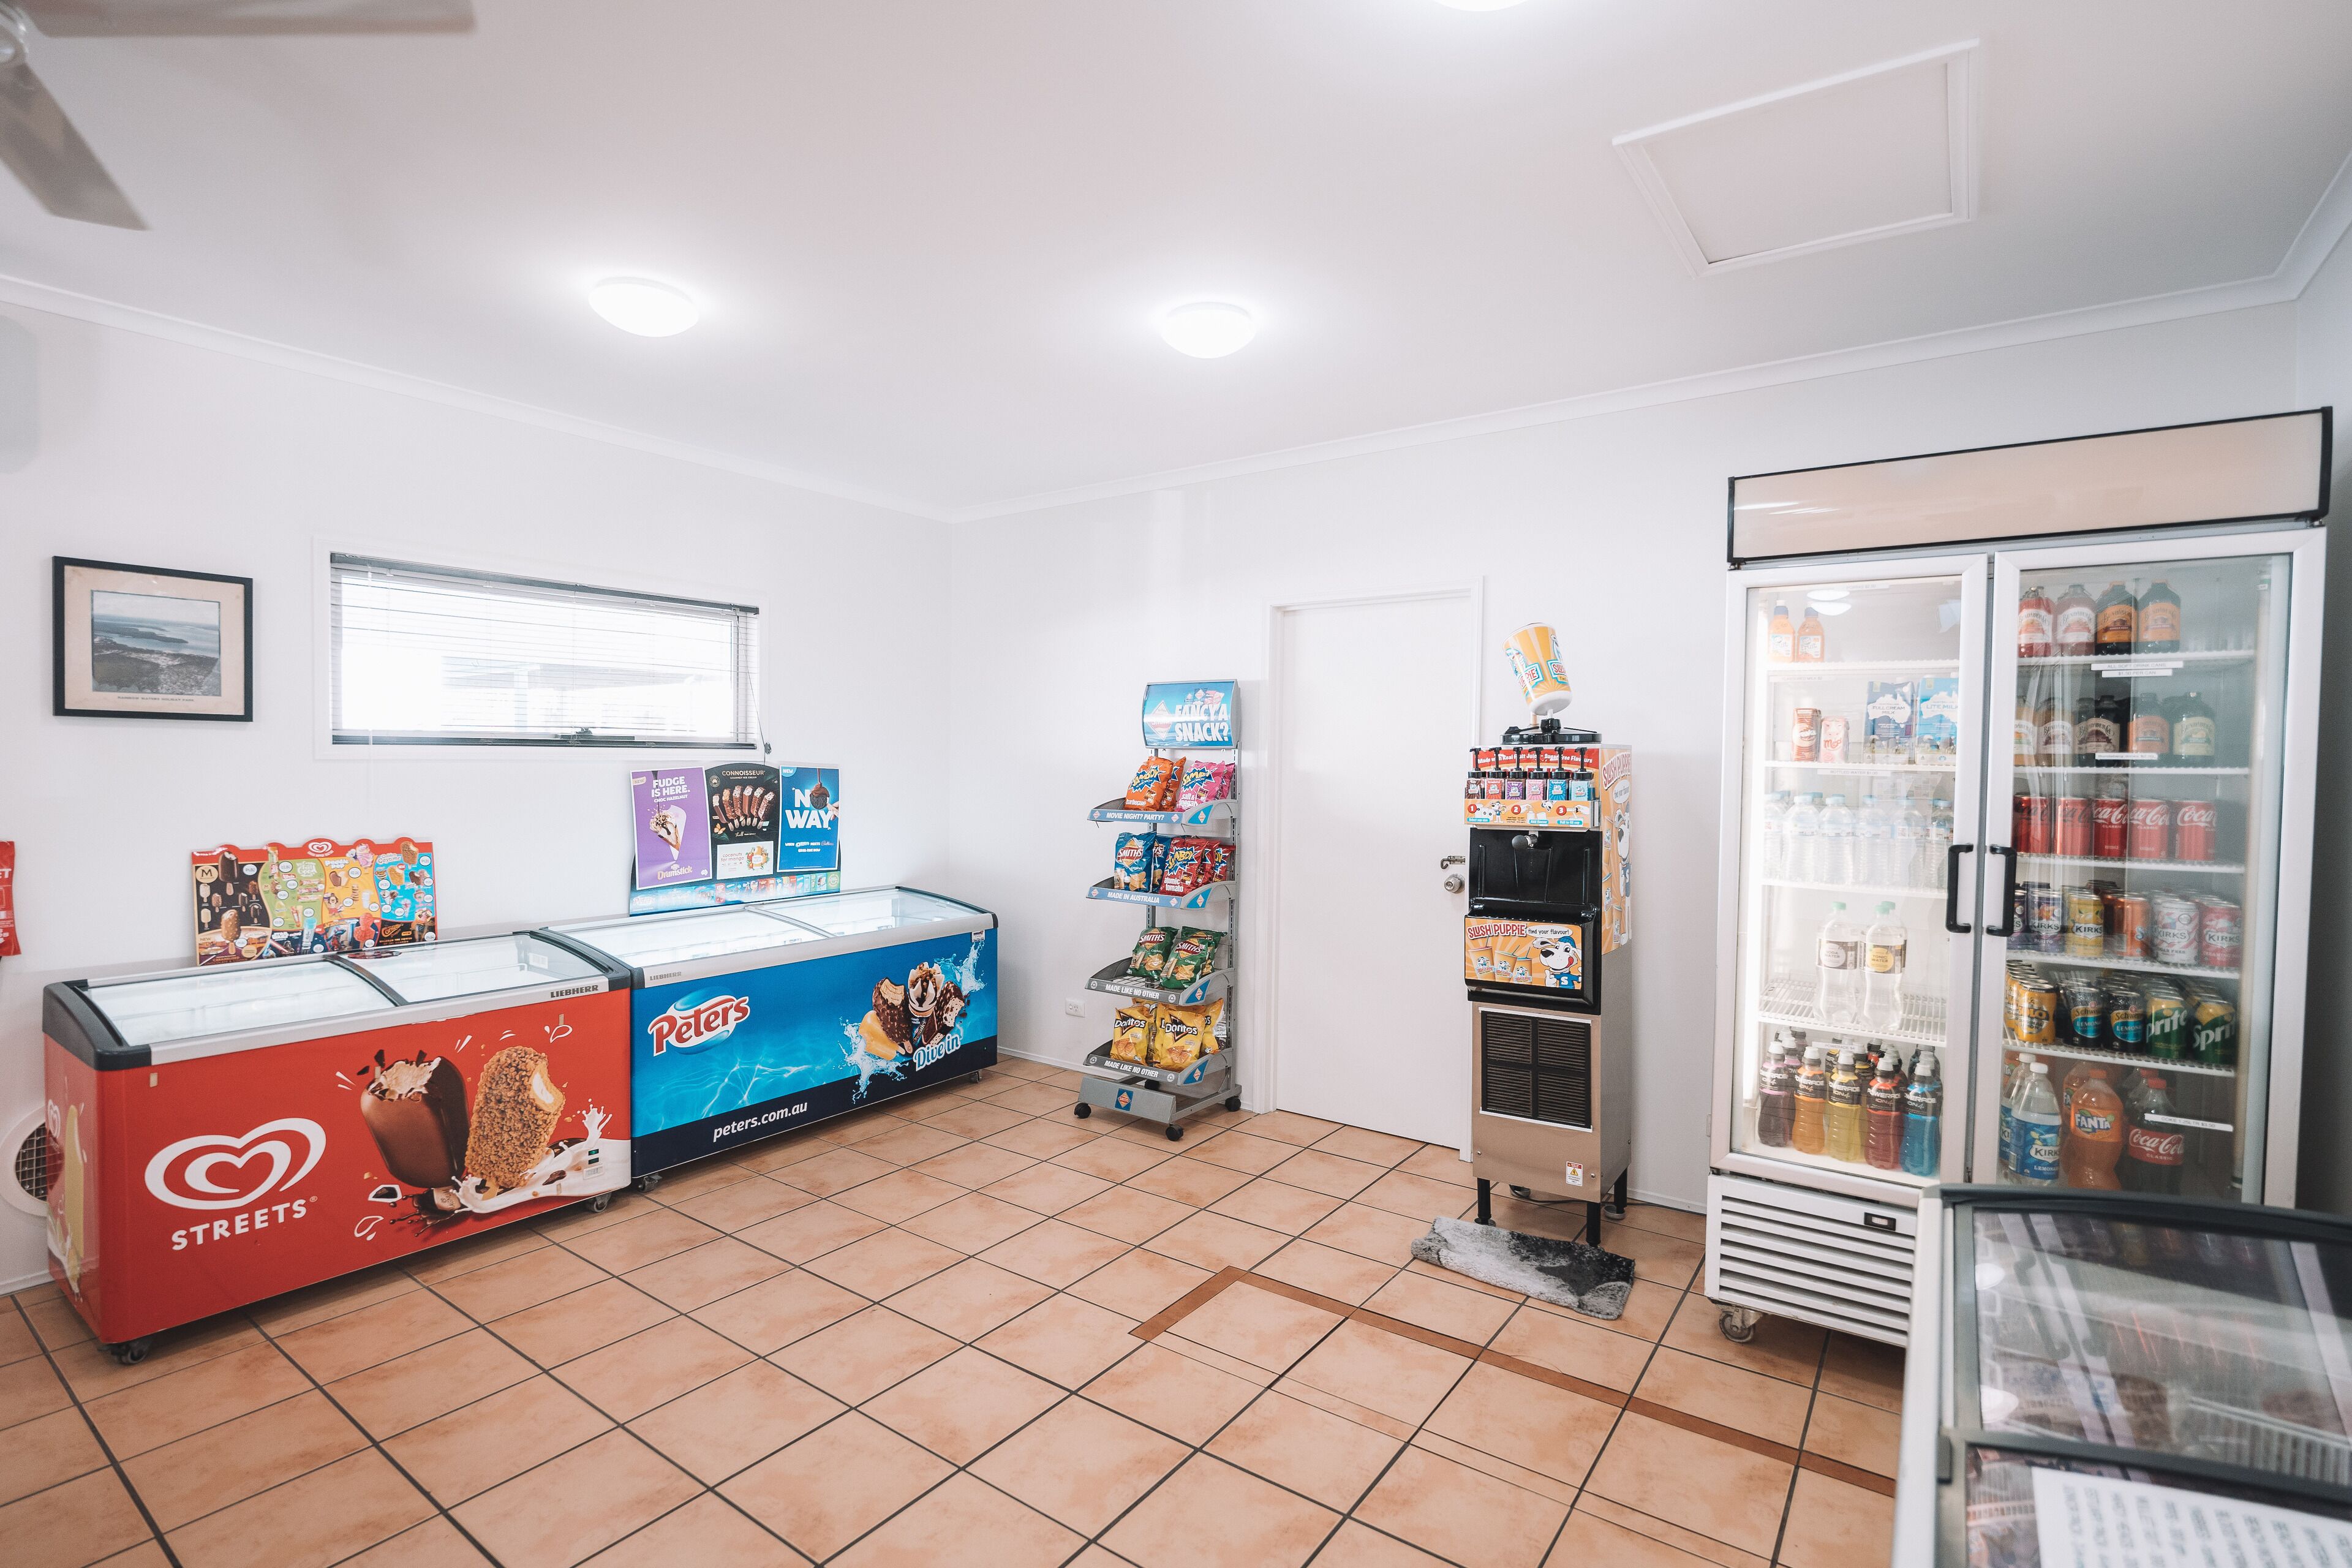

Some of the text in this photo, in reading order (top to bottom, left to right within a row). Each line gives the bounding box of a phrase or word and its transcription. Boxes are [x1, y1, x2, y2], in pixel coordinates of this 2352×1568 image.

[1175, 722, 1229, 742] SNACK?
[652, 776, 685, 788] FUDGE
[651, 785, 691, 797] IS HERE.
[201, 869, 213, 878] M
[657, 865, 693, 880] Drumstick
[1129, 894, 1160, 904] AUSTRALIA
[1468, 924, 1492, 939] SLUSH
[2076, 925, 2103, 934] KIRKS
[649, 971, 682, 982] LIEBHERR
[1561, 976, 1569, 986] S
[550, 984, 599, 998] LIEBHERR
[1105, 983, 1160, 1000] MADE LIKE NO OTHER
[649, 994, 749, 1055] Peters
[1114, 1018, 1147, 1029] Doritos
[1165, 1023, 1198, 1036] Doritos
[913, 1034, 961, 1072] Dive in
[1104, 1060, 1120, 1070] MADE
[1120, 1063, 1132, 1072] LIKE
[1140, 1068, 1159, 1078] OTHER
[713, 1102, 808, 1142] peters.com.au
[2075, 1112, 2111, 1130] FANTA
[171, 1199, 307, 1251] STREETS
